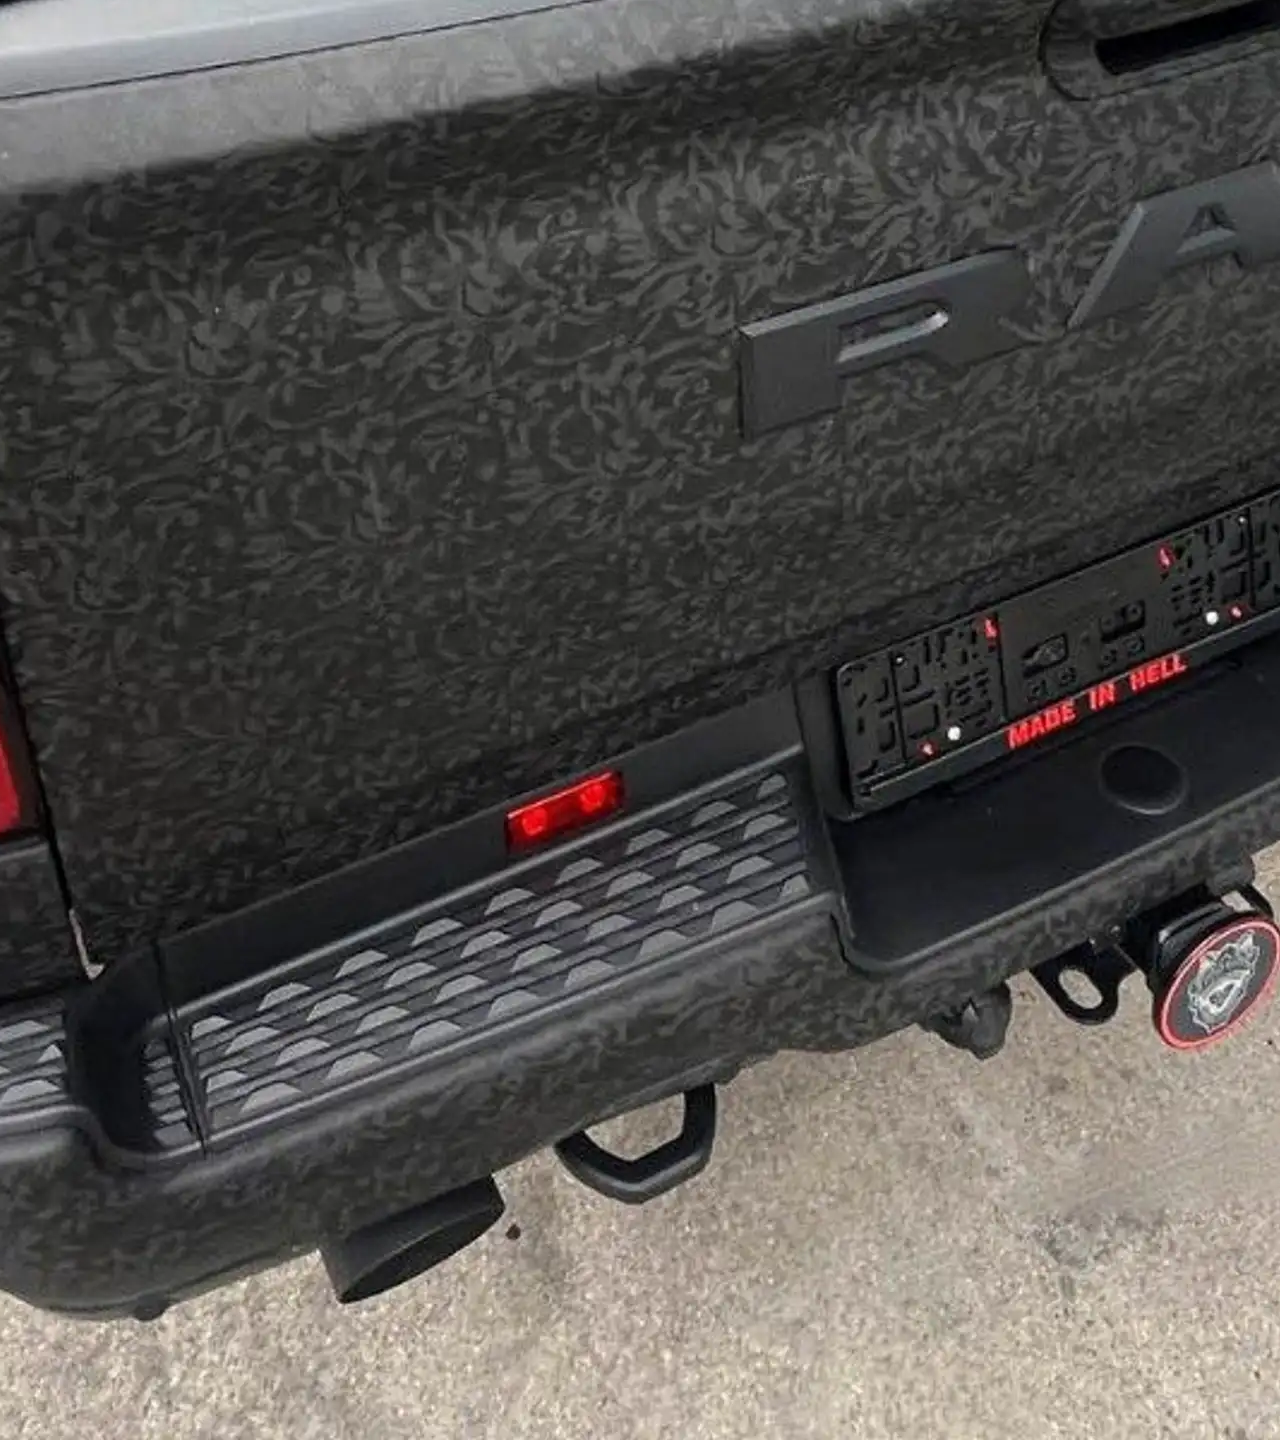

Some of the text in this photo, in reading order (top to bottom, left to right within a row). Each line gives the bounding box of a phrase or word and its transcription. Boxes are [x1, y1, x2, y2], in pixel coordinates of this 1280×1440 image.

[1006, 652, 1189, 750] MADE IN HELL
